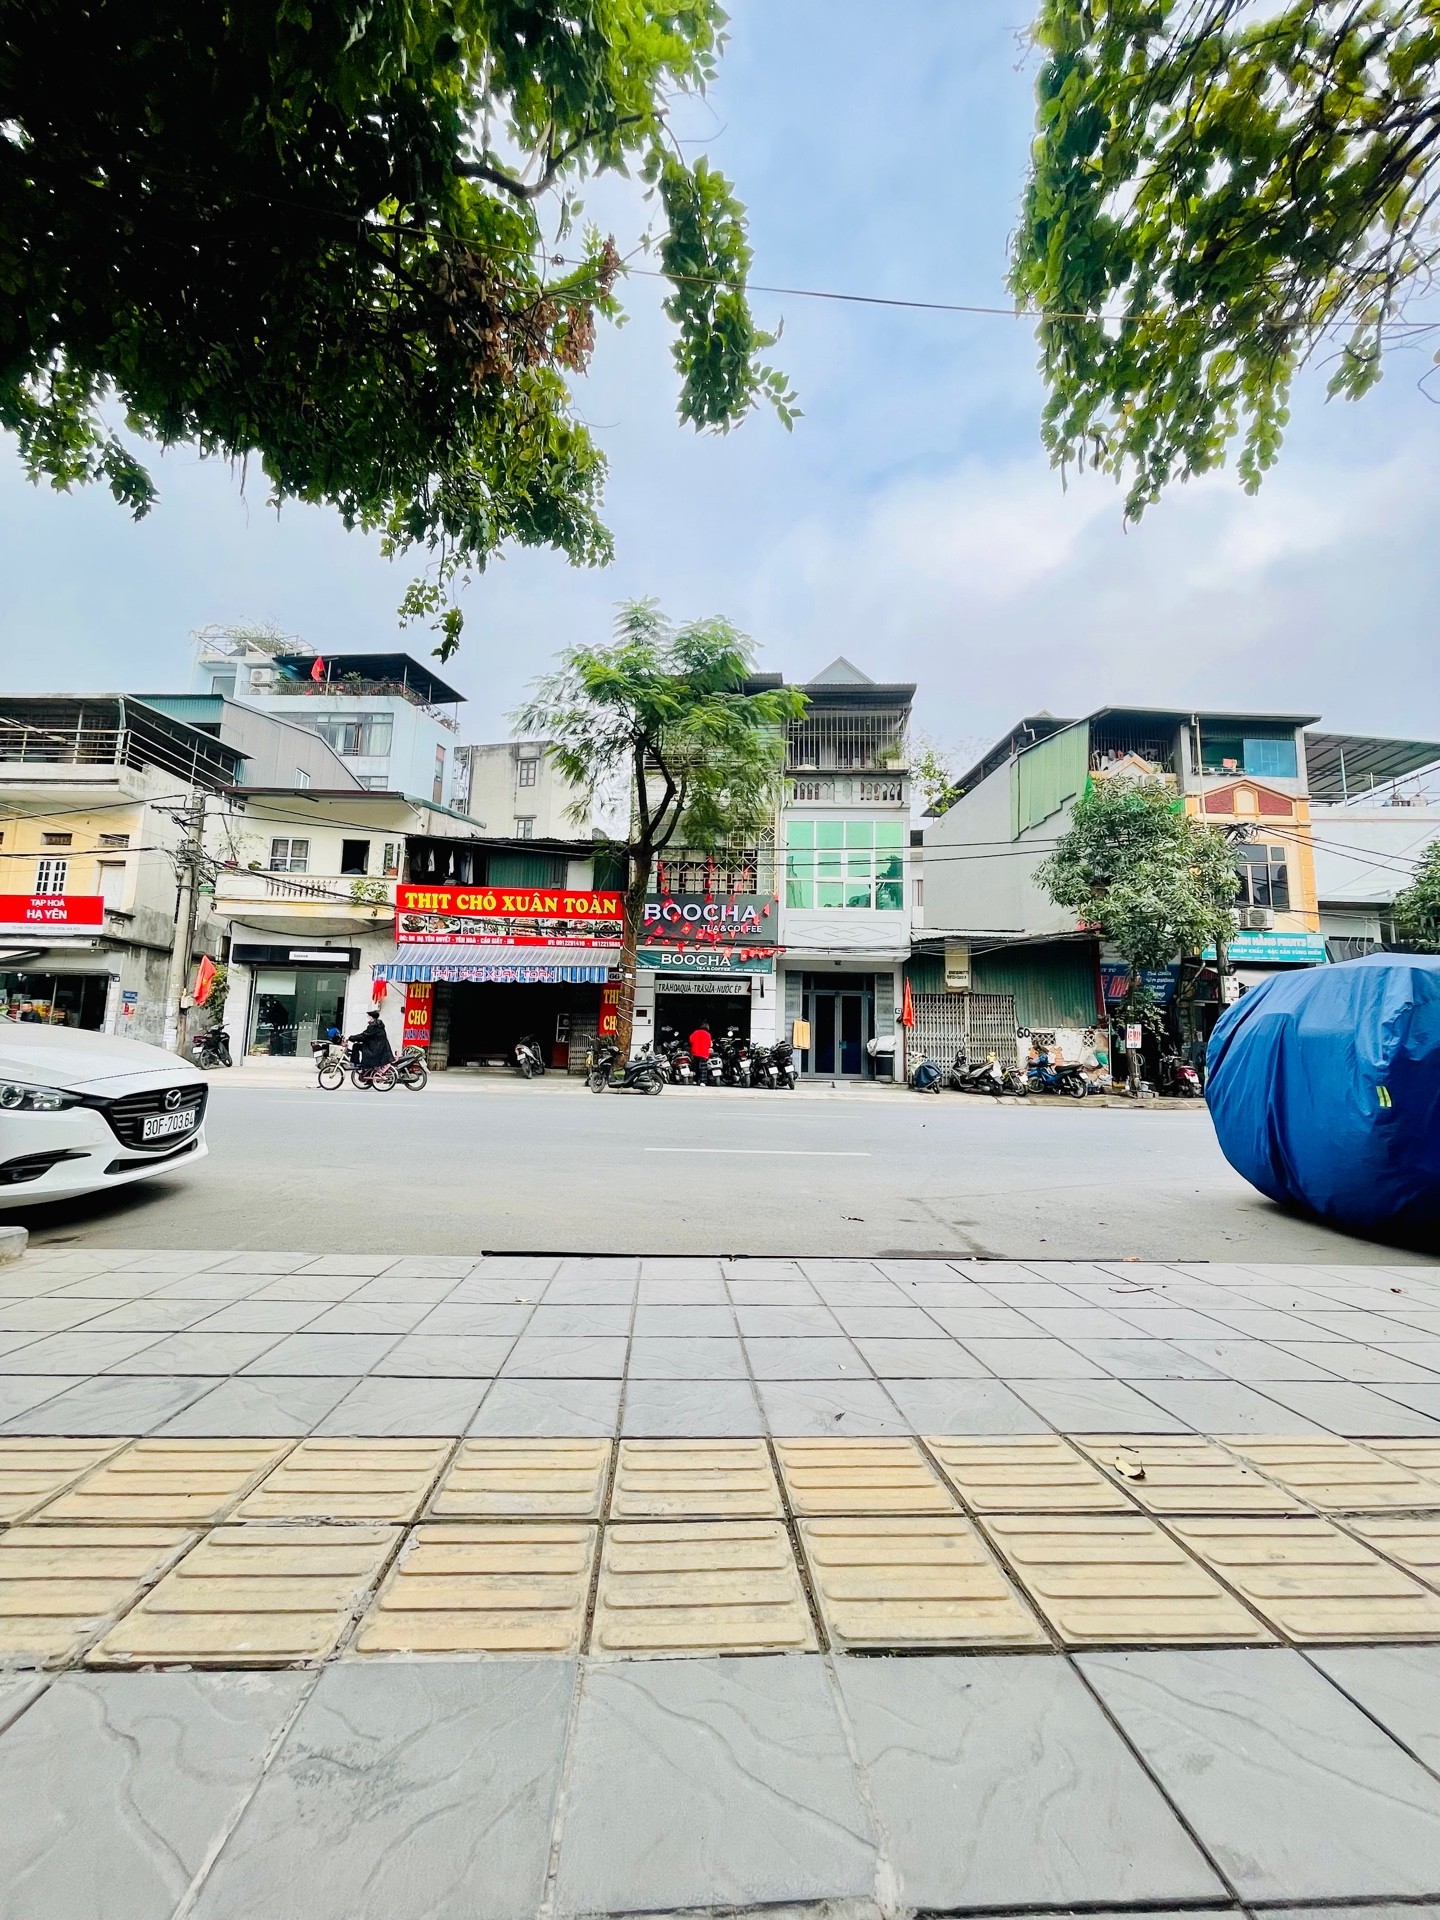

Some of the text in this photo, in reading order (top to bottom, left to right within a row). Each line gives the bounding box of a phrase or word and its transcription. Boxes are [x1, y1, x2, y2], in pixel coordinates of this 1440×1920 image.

[30, 898, 65, 907] TẠP HOÁ
[405, 891, 617, 914] THỊT CHÓ XUÂN TOÀN
[26, 907, 67, 920] HẠ YÊN
[644, 903, 757, 922] BOOCHA
[661, 953, 731, 967] BOOCHA
[409, 983, 431, 1002] THỊT
[408, 1005, 428, 1025] CHÓ
[603, 1015, 617, 1030] CH
[1016, 1027, 1030, 1038] 60
[145, 1112, 194, 1136] 30F-703.64
